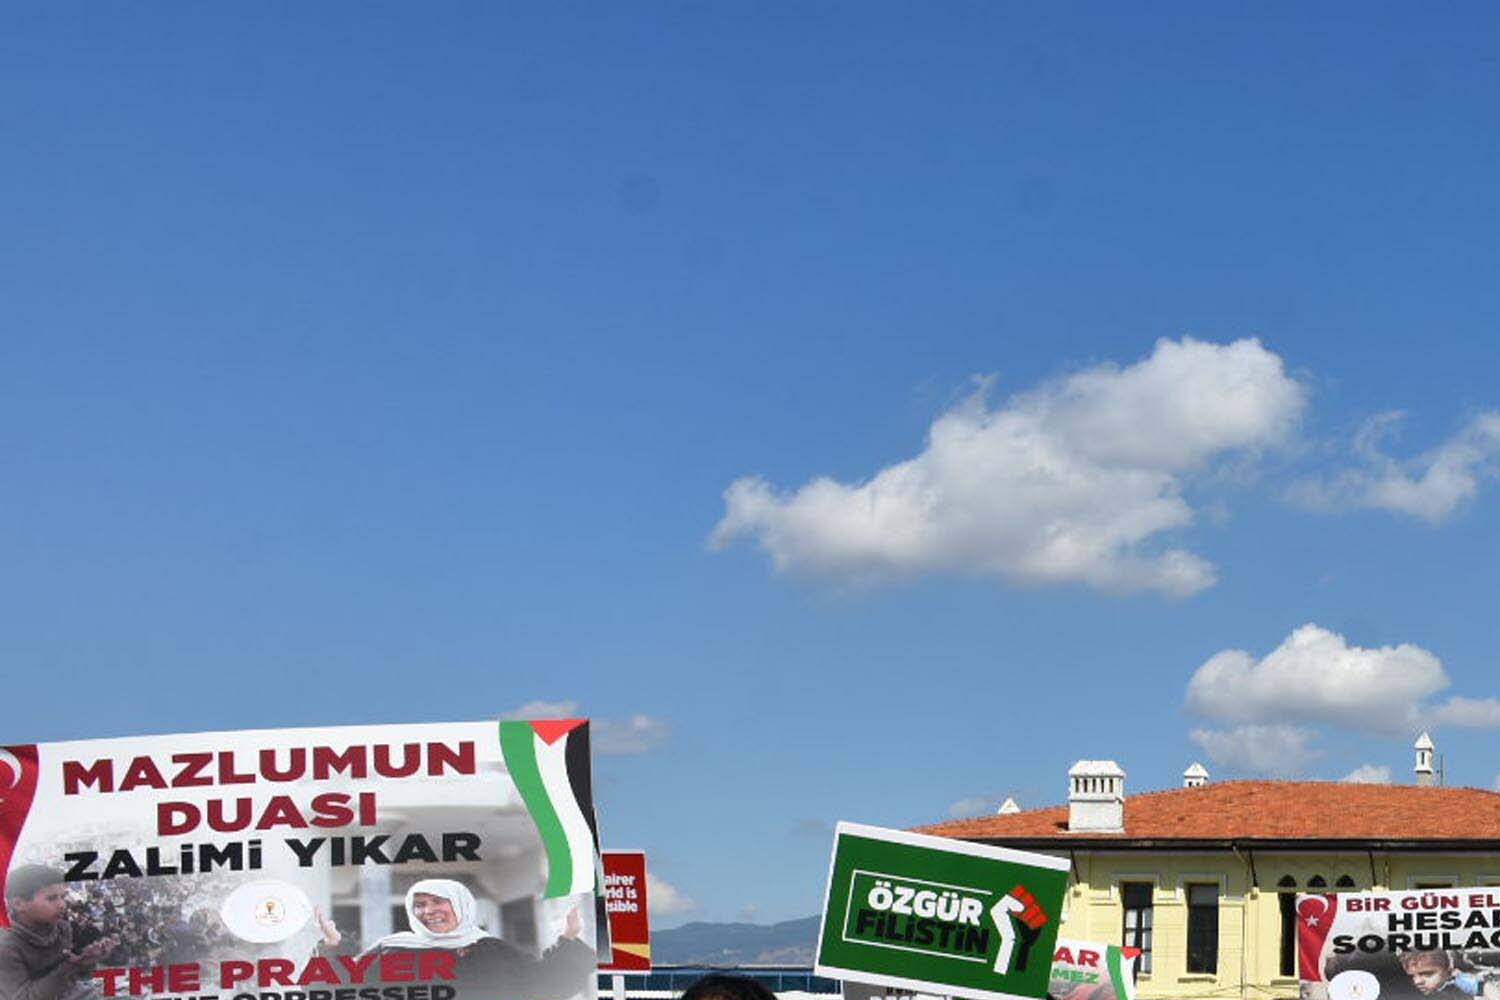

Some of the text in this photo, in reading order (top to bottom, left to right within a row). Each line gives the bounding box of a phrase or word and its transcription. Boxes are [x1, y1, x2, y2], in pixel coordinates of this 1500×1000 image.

[62, 741, 476, 795] MAZLUMUN
[157, 792, 377, 836] DUASI
[64, 832, 482, 882] ZALİMİ YIKAR
[604, 873, 636, 886] airer
[1401, 892, 1460, 910] GÜN
[867, 880, 984, 927] ÖZGÜR
[92, 951, 458, 997] THE PRAYER
[1052, 968, 1100, 985] MEZ
[1053, 946, 1101, 968] AR
